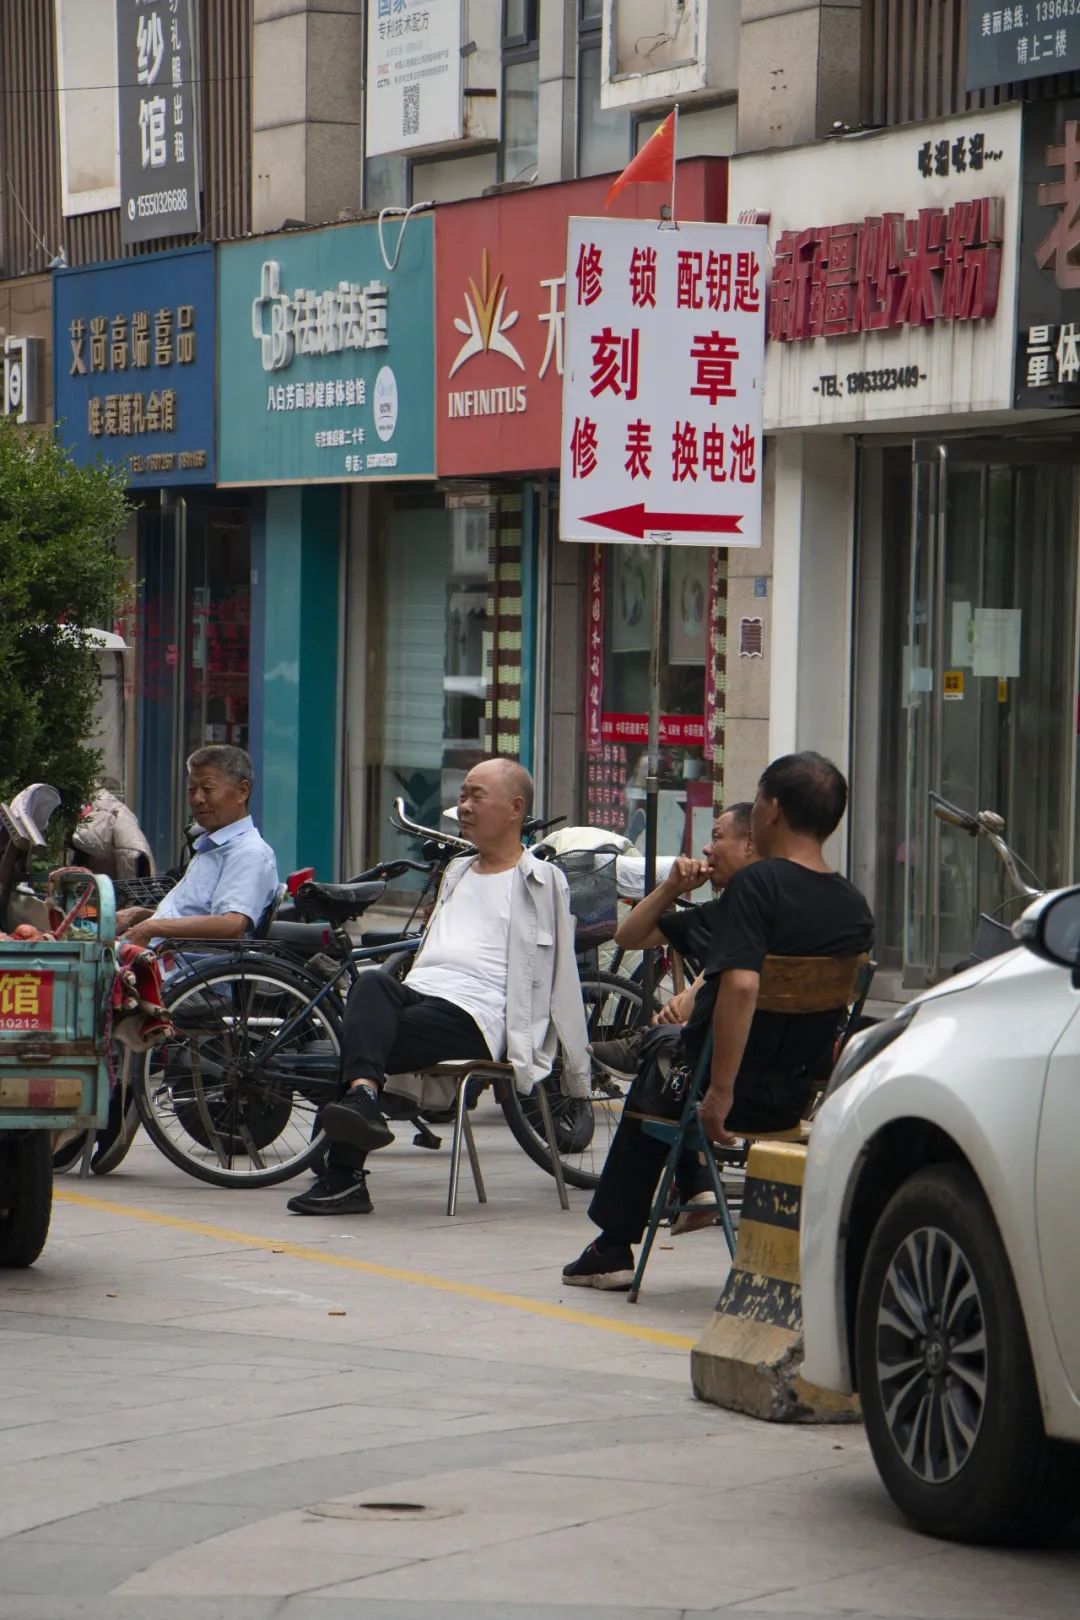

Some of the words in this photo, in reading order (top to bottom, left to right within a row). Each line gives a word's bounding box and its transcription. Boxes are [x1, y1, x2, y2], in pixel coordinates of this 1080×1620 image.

[1017, 28, 1067, 65] 请上二楼
[136, 0, 167, 169] 纱馆
[137, 188, 188, 216] 15550326688
[676, 249, 760, 313] 配钥匙
[767, 197, 1003, 342] 新疆炒米粉
[69, 304, 196, 375] 艾尚高端喜品
[448, 386, 528, 418] INFINITUS
[671, 420, 757, 484] 换电池
[0, 973, 41, 1015] 馆
